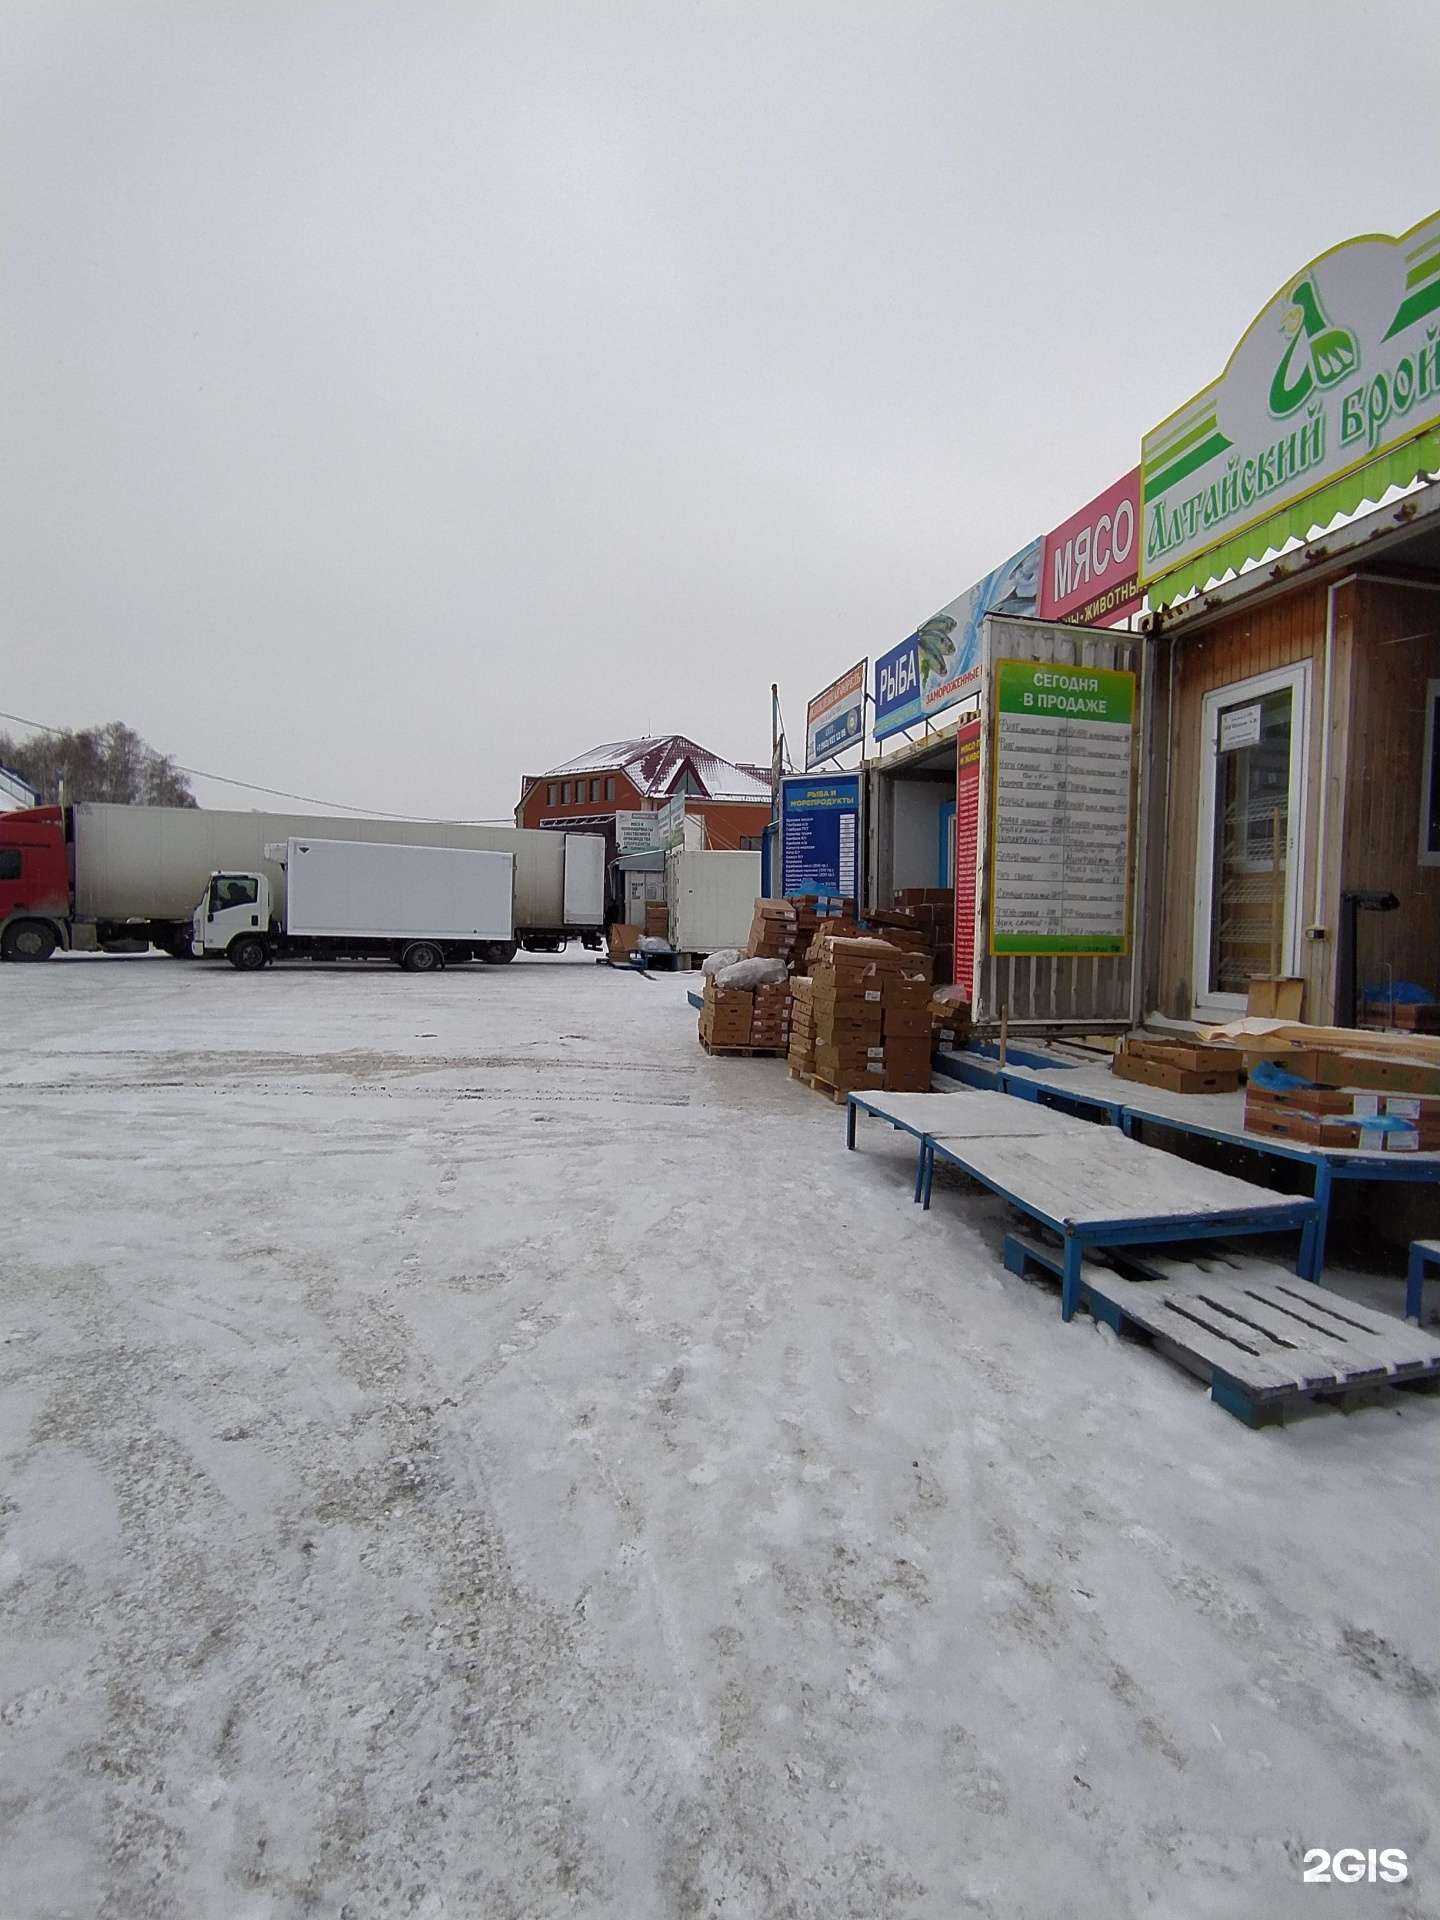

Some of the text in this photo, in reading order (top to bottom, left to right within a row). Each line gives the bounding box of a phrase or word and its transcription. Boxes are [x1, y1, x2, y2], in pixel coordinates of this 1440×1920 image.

[1053, 498, 1135, 603] МЯСО
[879, 649, 917, 706] РЫБА
[1033, 673, 1098, 692] СЕГОДНЯ
[1023, 692, 1107, 714] В ПРОДАЖЕ
